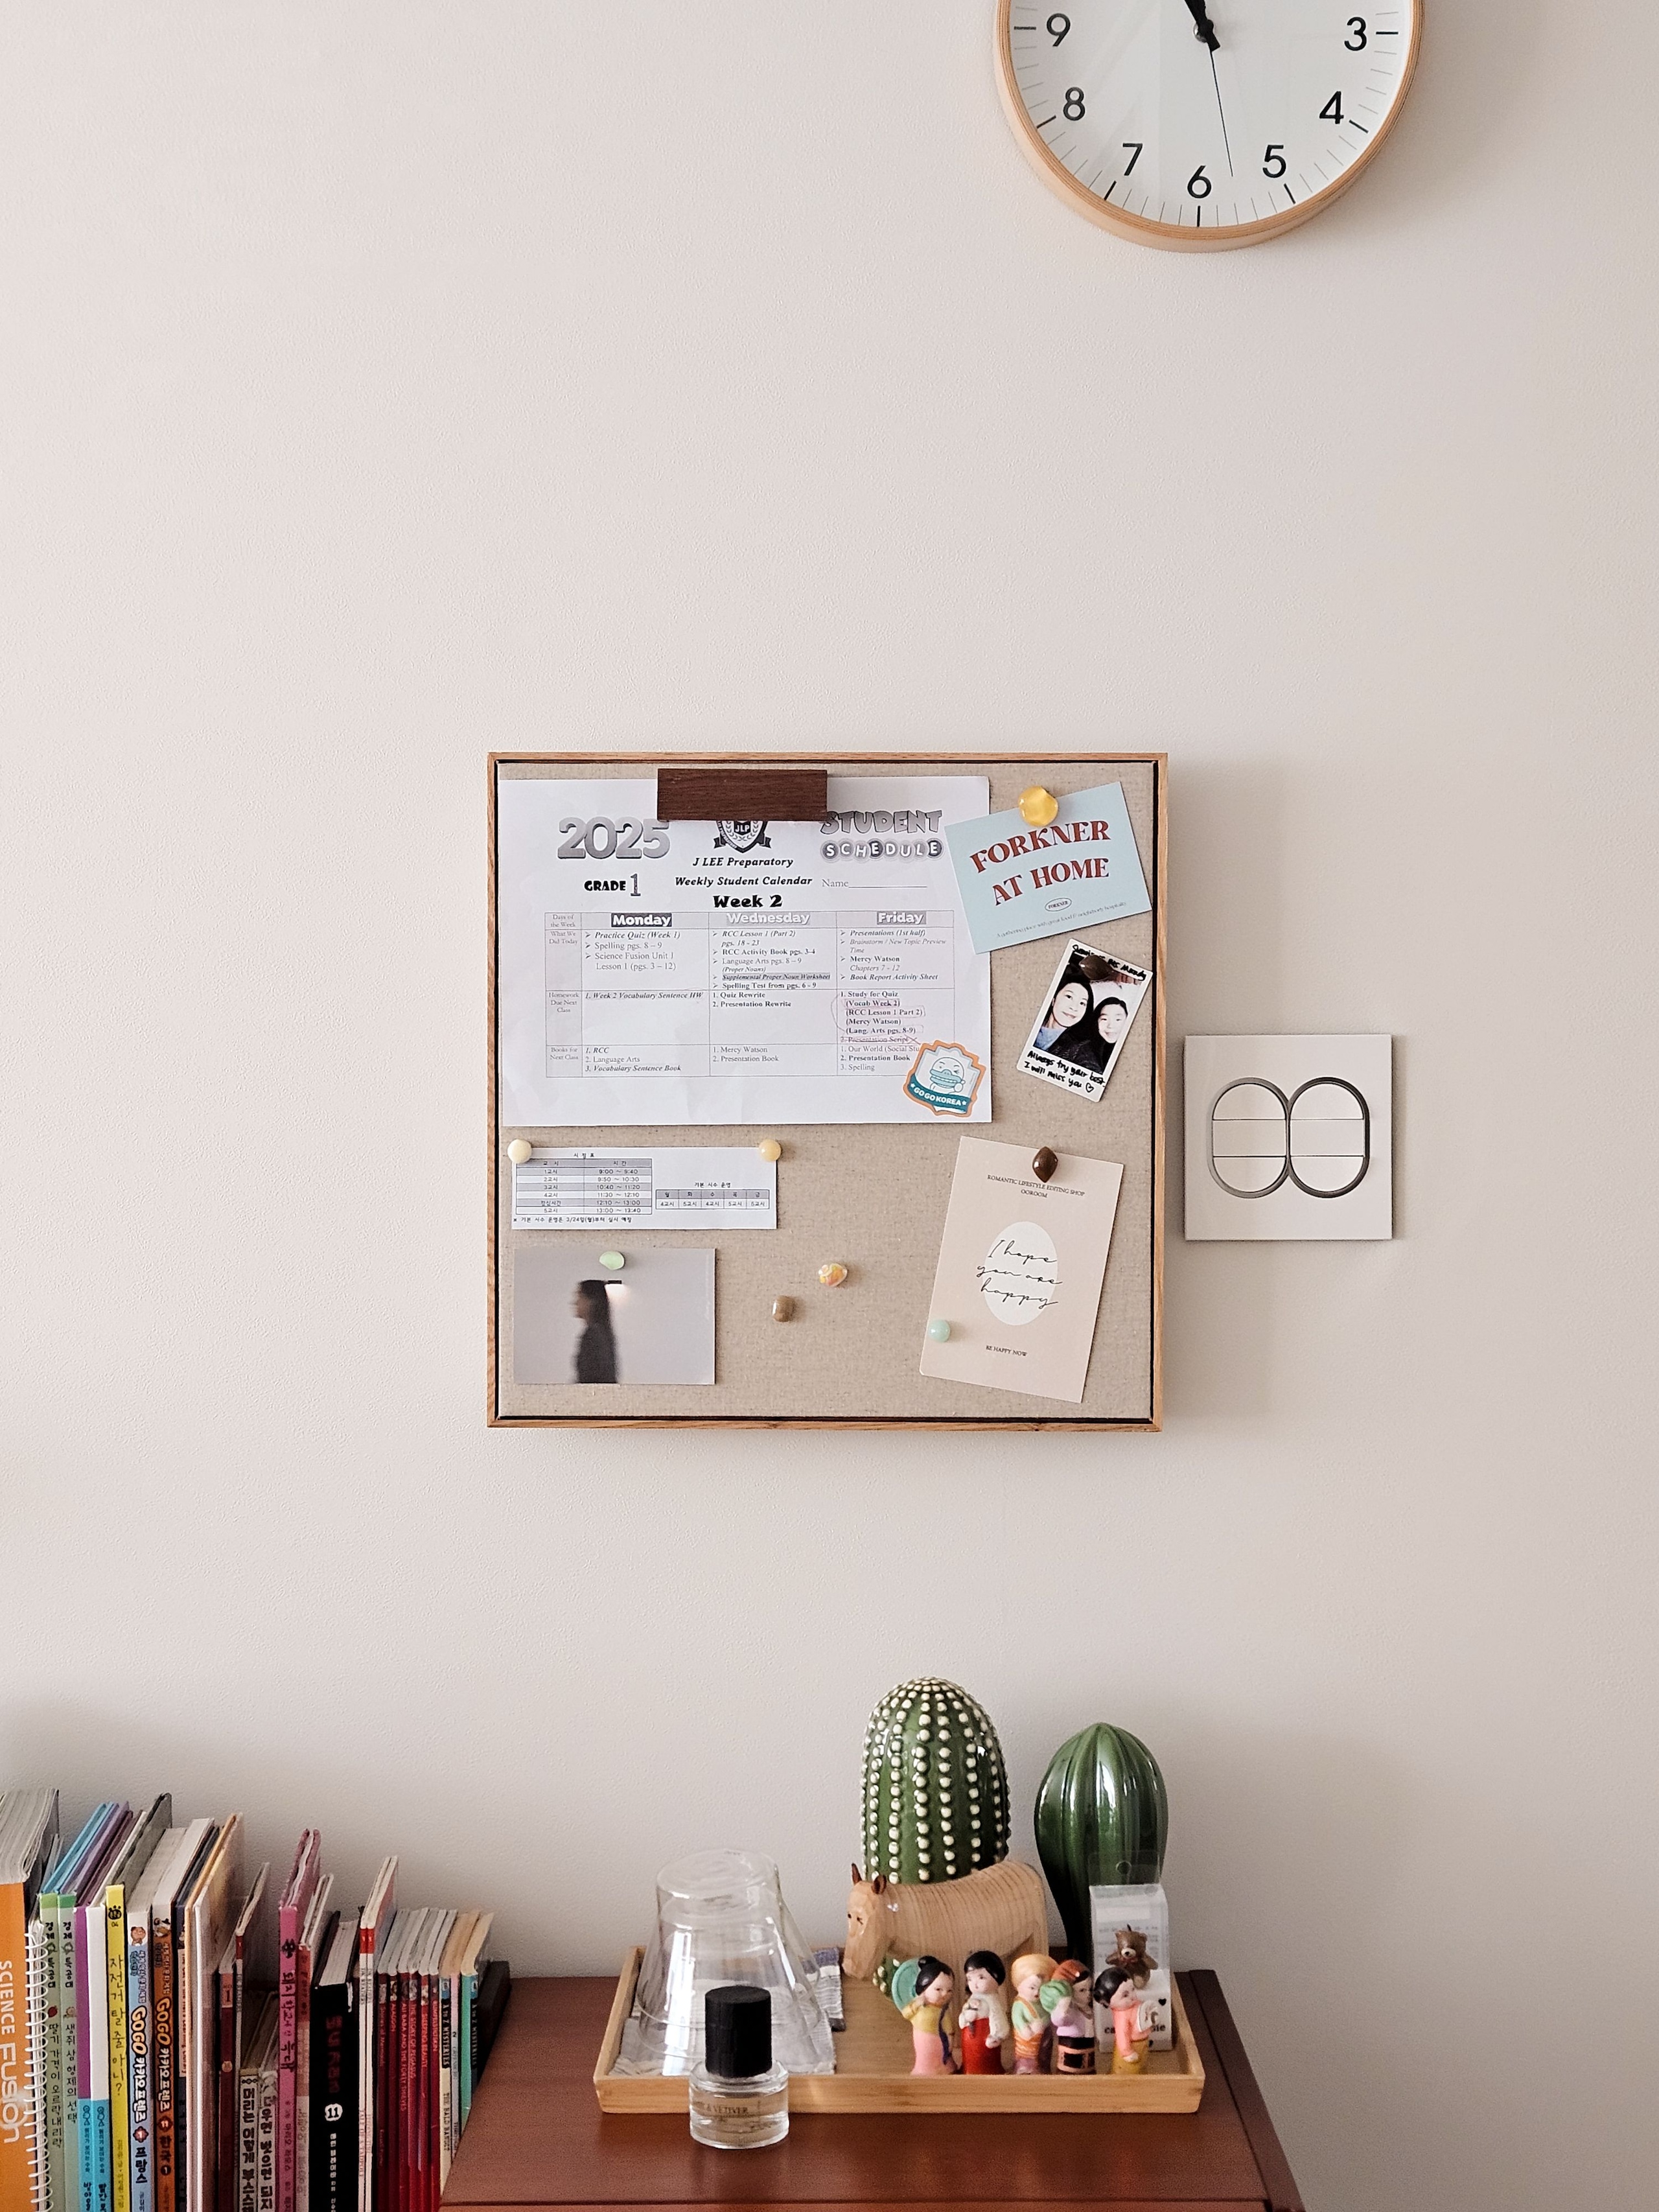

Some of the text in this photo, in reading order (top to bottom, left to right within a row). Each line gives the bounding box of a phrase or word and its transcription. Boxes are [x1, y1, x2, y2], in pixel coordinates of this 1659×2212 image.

[1047, 13, 1071, 47] 9
[1343, 16, 1367, 51] 3
[1063, 86, 1085, 121] 8
[1319, 91, 1344, 124] 4
[1122, 143, 1143, 176] 7
[1262, 145, 1286, 178] 5
[1187, 165, 1211, 198] 6
[557, 816, 670, 859] 2025
[820, 810, 942, 835] STUDENT
[693, 857, 793, 868] J LEE Preparatory
[824, 839, 940, 859] SCHEDULE
[969, 820, 1111, 874] FORKNER
[585, 873, 641, 896] GRADE 1
[675, 876, 812, 887] Weekly Student Calendar
[993, 858, 1109, 905] AT HOME
[713, 894, 783, 907] Week 2
[612, 914, 671, 927] Monday
[726, 913, 810, 925] Wednesday
[878, 911, 923, 924] Friday
[721, 1047, 741, 1055] Mercy
[1057, 1060, 1069, 1073] try
[1031, 1065, 1045, 1075] will
[1047, 1071, 1066, 1082] miss
[1068, 1078, 1082, 1088] you
[914, 1088, 962, 1106] GO GO KOREA
[987, 1174, 1017, 1185] ROMANTIC
[1018, 1180, 1045, 1190] LIFESTYLE
[1047, 1185, 1069, 1194] EDITING
[1021, 1189, 1048, 1198] OOROOM
[988, 1239, 1058, 1264] I hope
[976, 1264, 1063, 1285] you are
[980, 1277, 1059, 1310] happy
[993, 1346, 1012, 1355] HAPPY
[45, 1922, 56, 1988] 경제 특공대
[63, 1922, 73, 1988] 경제 특공대
[0, 1960, 15, 2035] SCIENCE
[110, 1954, 124, 2096] 자전거 탈 줄 아니?
[281, 1972, 296, 2069] 돼지 늑대
[132, 2005, 147, 2123] GOGO 카카오프렌즈
[156, 1997, 172, 2112] GOGO 카카오프렌즈
[49, 2023, 62, 2148] 딸기 가격이 오르락내리락
[65, 2023, 77, 2124] 생쥐 삼 형제의 선택
[328, 2106, 339, 2119] 11
[135, 2147, 148, 2183] 프랑스
